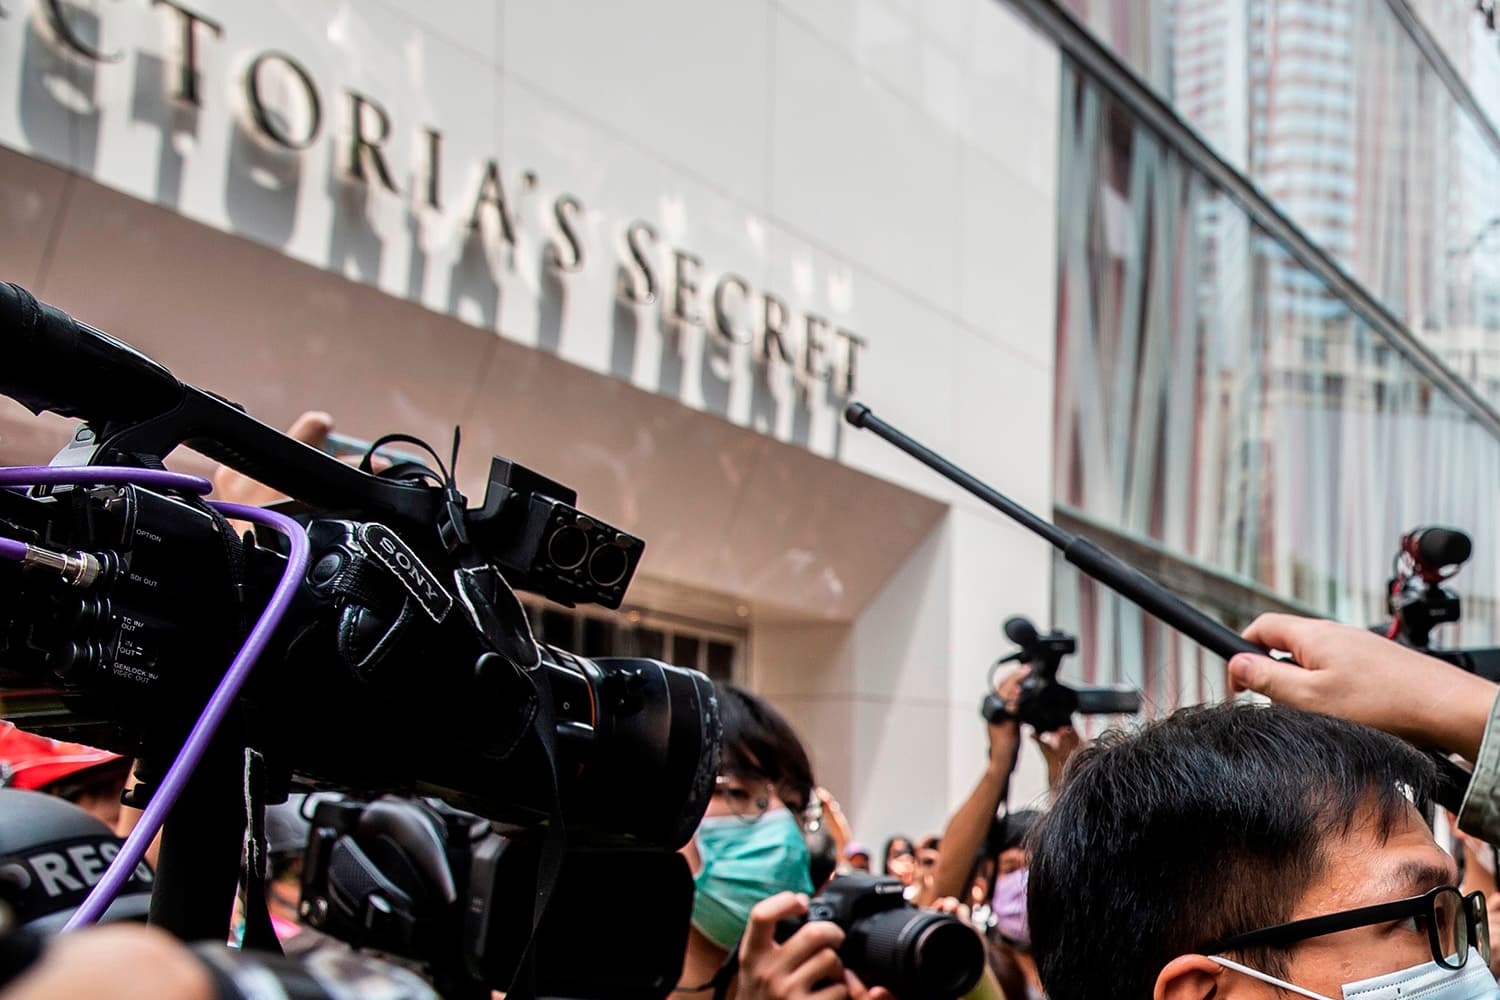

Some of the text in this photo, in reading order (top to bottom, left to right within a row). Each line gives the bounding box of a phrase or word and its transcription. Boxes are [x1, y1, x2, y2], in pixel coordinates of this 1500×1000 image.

[0, 0, 868, 397] CTORIA'S SECRET
[135, 528, 162, 543] OPTION
[379, 536, 438, 599] SONY
[143, 577, 158, 588] OUT
[121, 622, 136, 632] OUT
[119, 646, 136, 657] OUT
[113, 661, 147, 677] GENLOCK
